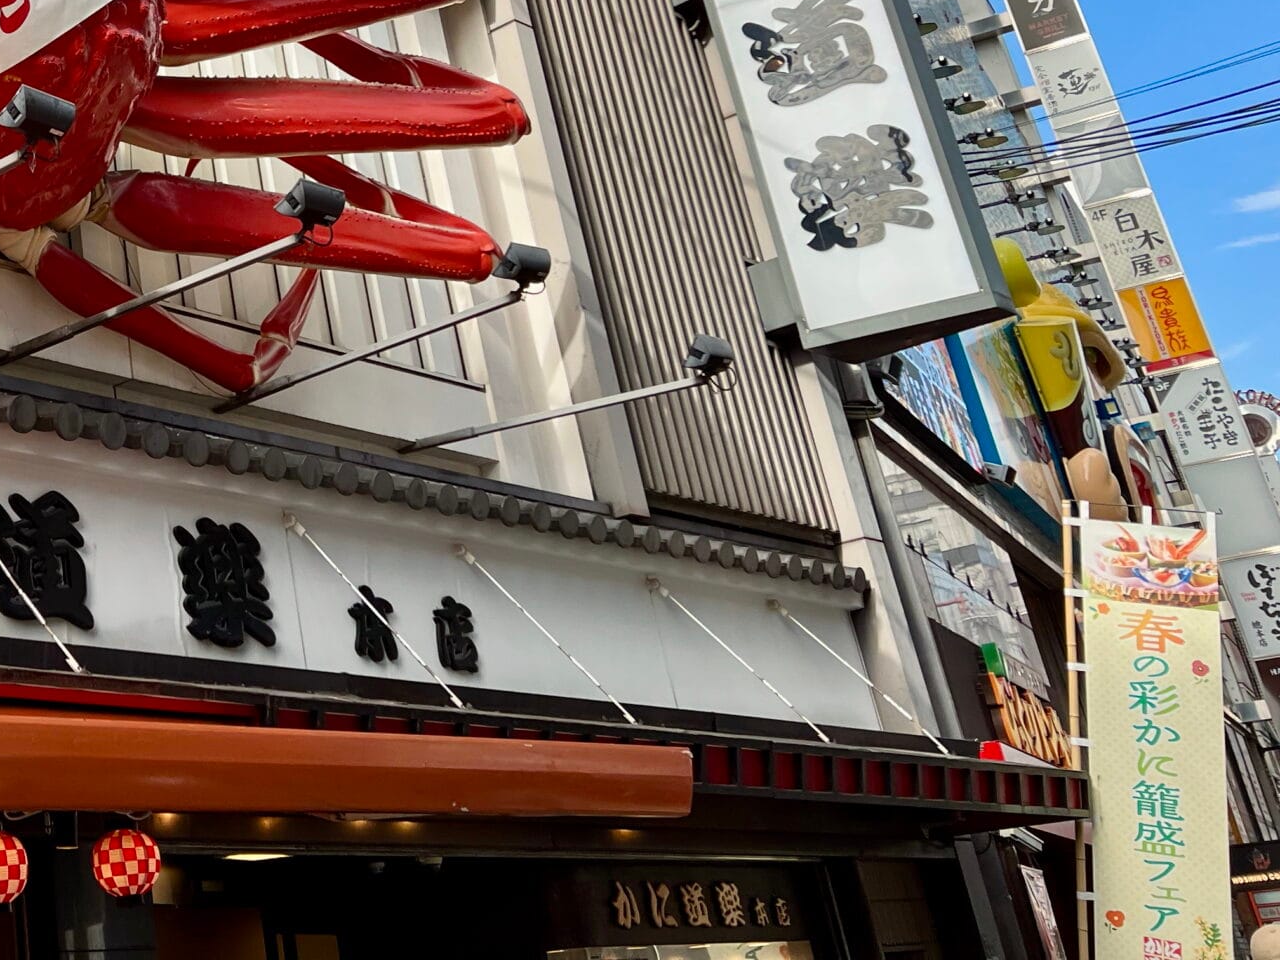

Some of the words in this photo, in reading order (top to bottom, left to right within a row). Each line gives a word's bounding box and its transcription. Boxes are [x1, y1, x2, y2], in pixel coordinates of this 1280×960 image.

[1092, 209, 1107, 221] 4F
[1114, 208, 1165, 277] 白木屋
[1117, 609, 1187, 932] 春の彩かに籠盛フェア
